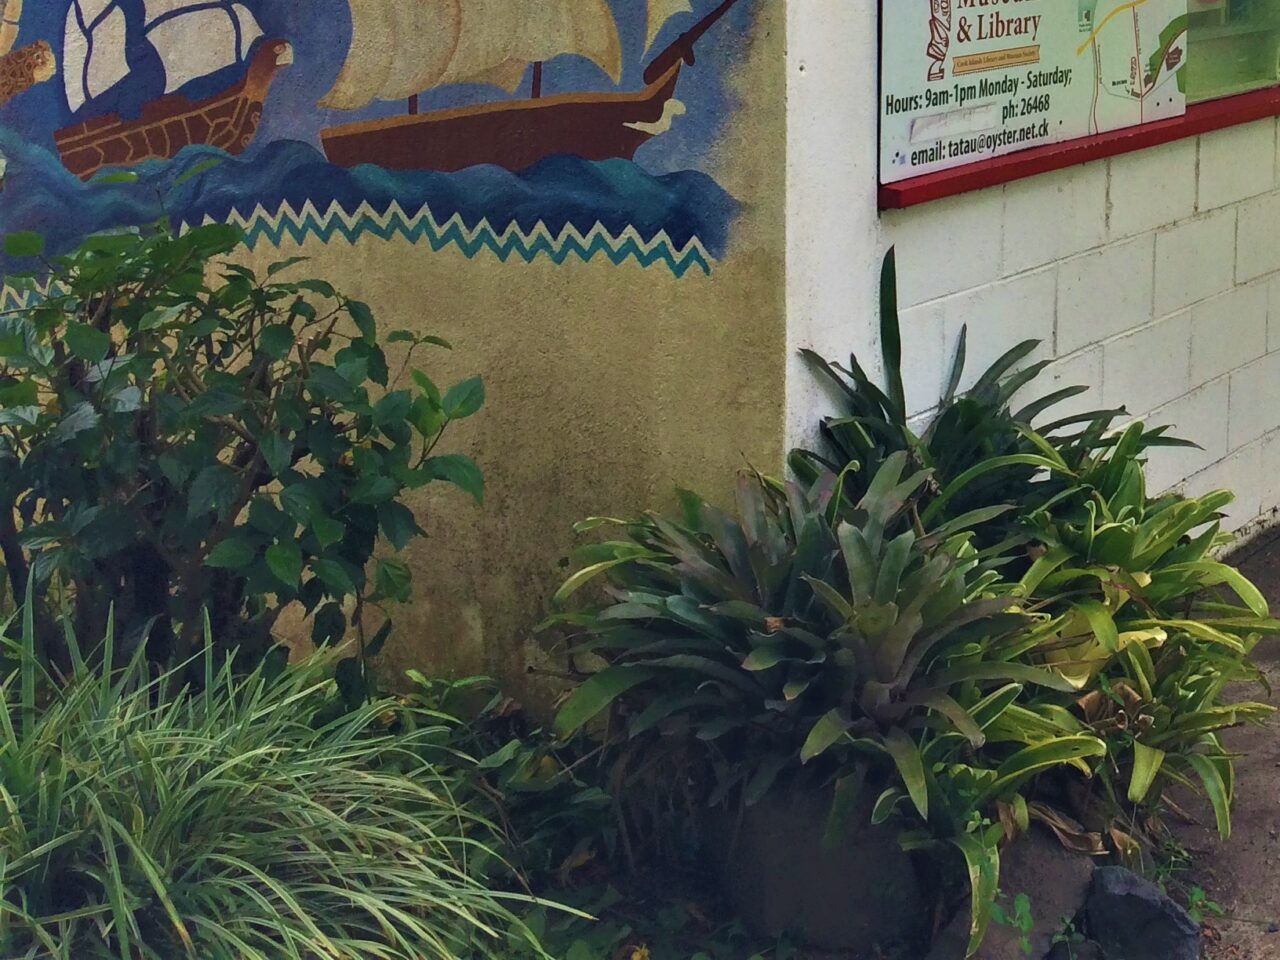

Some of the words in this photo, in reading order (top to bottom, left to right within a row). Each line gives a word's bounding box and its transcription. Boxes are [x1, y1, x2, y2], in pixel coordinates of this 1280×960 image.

[956, 14, 972, 43] &
[976, 11, 1042, 45] Library
[885, 93, 923, 116] Hours:
[925, 82, 976, 108] 9am-1pm
[979, 75, 1020, 98] Monday
[1026, 65, 1072, 90] Saturday;
[1002, 100, 1018, 124] ph:
[1020, 93, 1050, 116] 26468
[911, 142, 946, 166] email:
[948, 118, 1049, 156] tatau@oyster.net.ck
